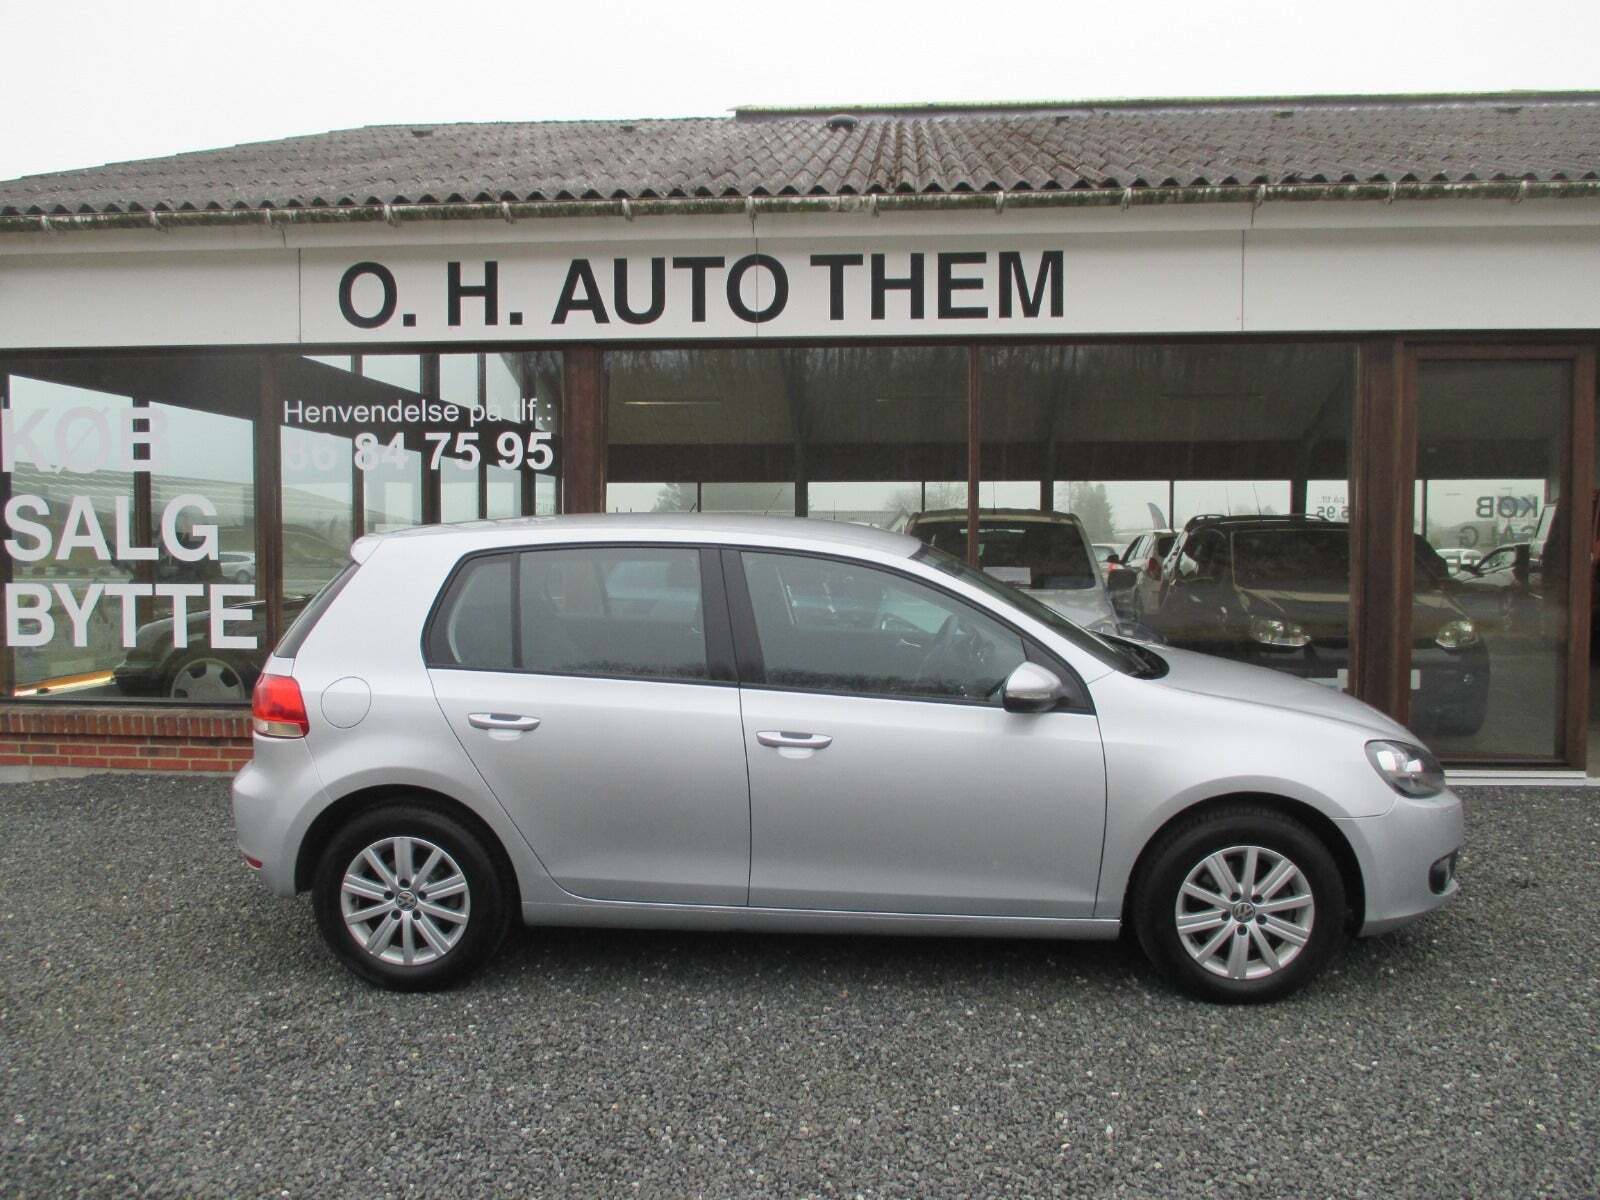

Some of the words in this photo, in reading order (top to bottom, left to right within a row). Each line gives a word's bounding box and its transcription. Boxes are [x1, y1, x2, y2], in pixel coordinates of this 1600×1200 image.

[338, 261, 417, 328] O.
[447, 260, 523, 326] H.
[551, 254, 789, 324] AUTO
[810, 250, 1065, 320] THEM
[2, 404, 168, 474] KØB
[284, 399, 459, 423] Henvendelse
[470, 397, 502, 427] på
[354, 432, 411, 471] 84
[425, 431, 481, 471] 75
[496, 431, 554, 471] 95
[3, 494, 220, 562] SALG
[5, 582, 259, 650] BYTTE
